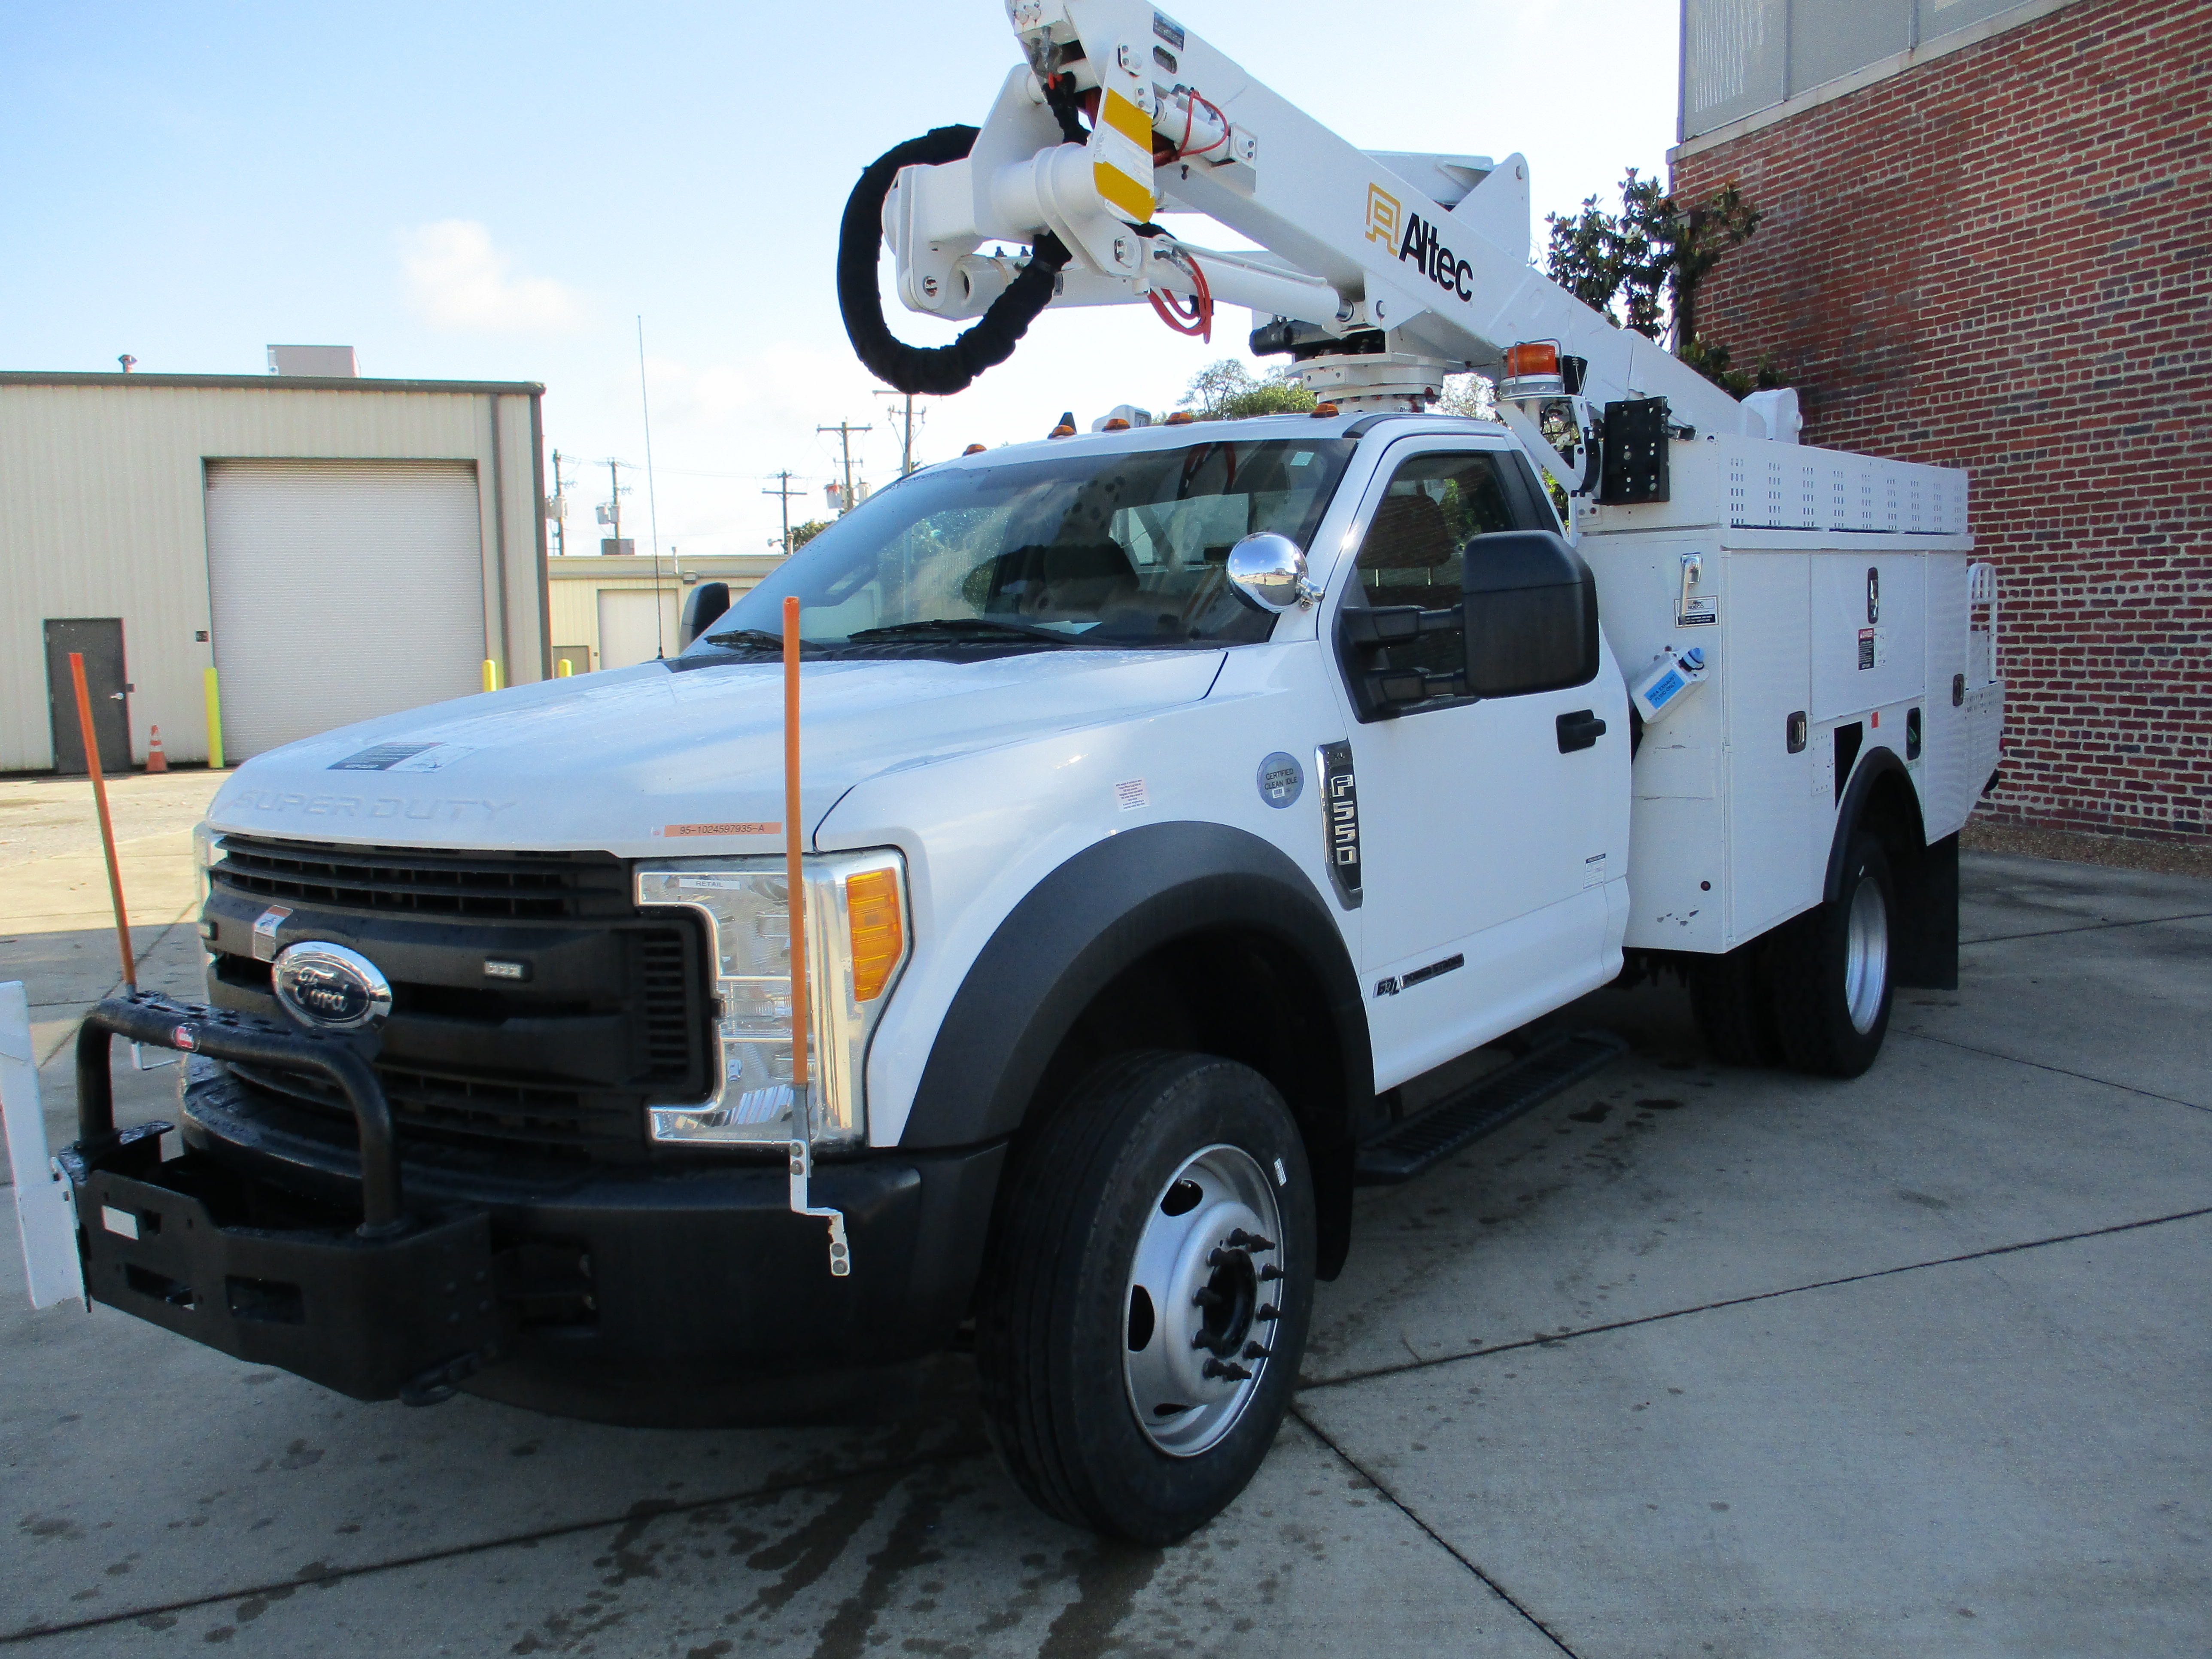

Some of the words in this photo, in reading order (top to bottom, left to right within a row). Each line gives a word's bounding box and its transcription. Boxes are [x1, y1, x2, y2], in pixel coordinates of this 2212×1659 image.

[1399, 212, 1474, 302] Altec
[1649, 690, 1659, 701] UREA
[1659, 674, 1676, 691] EXHAUST
[1654, 690, 1666, 702] FLUID
[1666, 681, 1676, 692] ONLY
[1264, 780, 1284, 790] CLEAN
[1285, 776, 1298, 785] IDLE
[1266, 768, 1294, 780] CERTIFIED
[236, 790, 362, 817] SUPER
[366, 796, 518, 821] DUTY
[680, 824, 765, 835] 95-1024597935-A
[293, 966, 349, 1012] Ford
